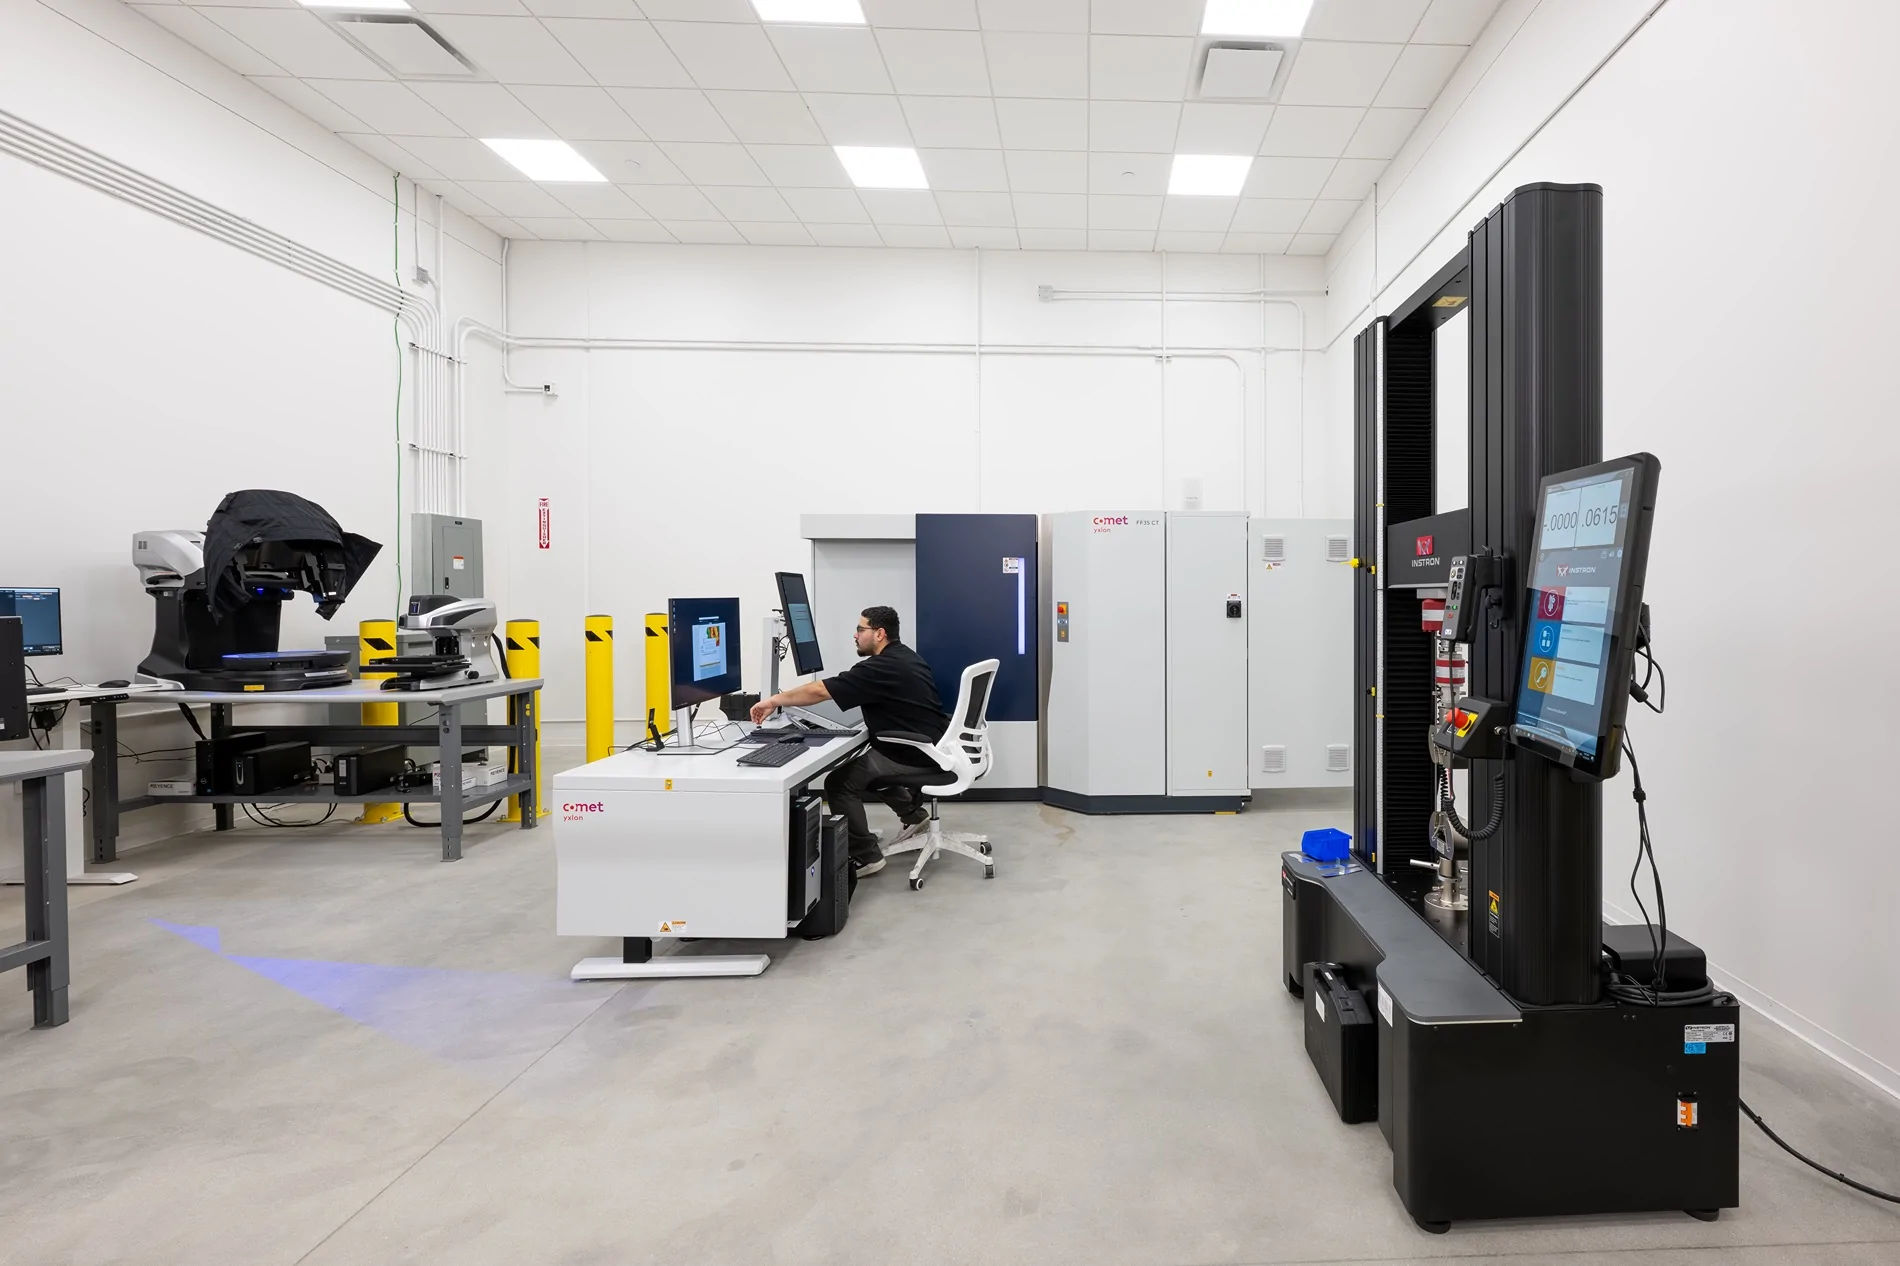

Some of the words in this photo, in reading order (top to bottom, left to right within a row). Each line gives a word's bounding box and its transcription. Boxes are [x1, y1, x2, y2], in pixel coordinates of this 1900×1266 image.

[1581, 505, 1618, 528] .0615
[1411, 557, 1440, 567] INSTRON
[1569, 566, 1596, 574] INSTRON
[490, 768, 505, 776] KEYENCE
